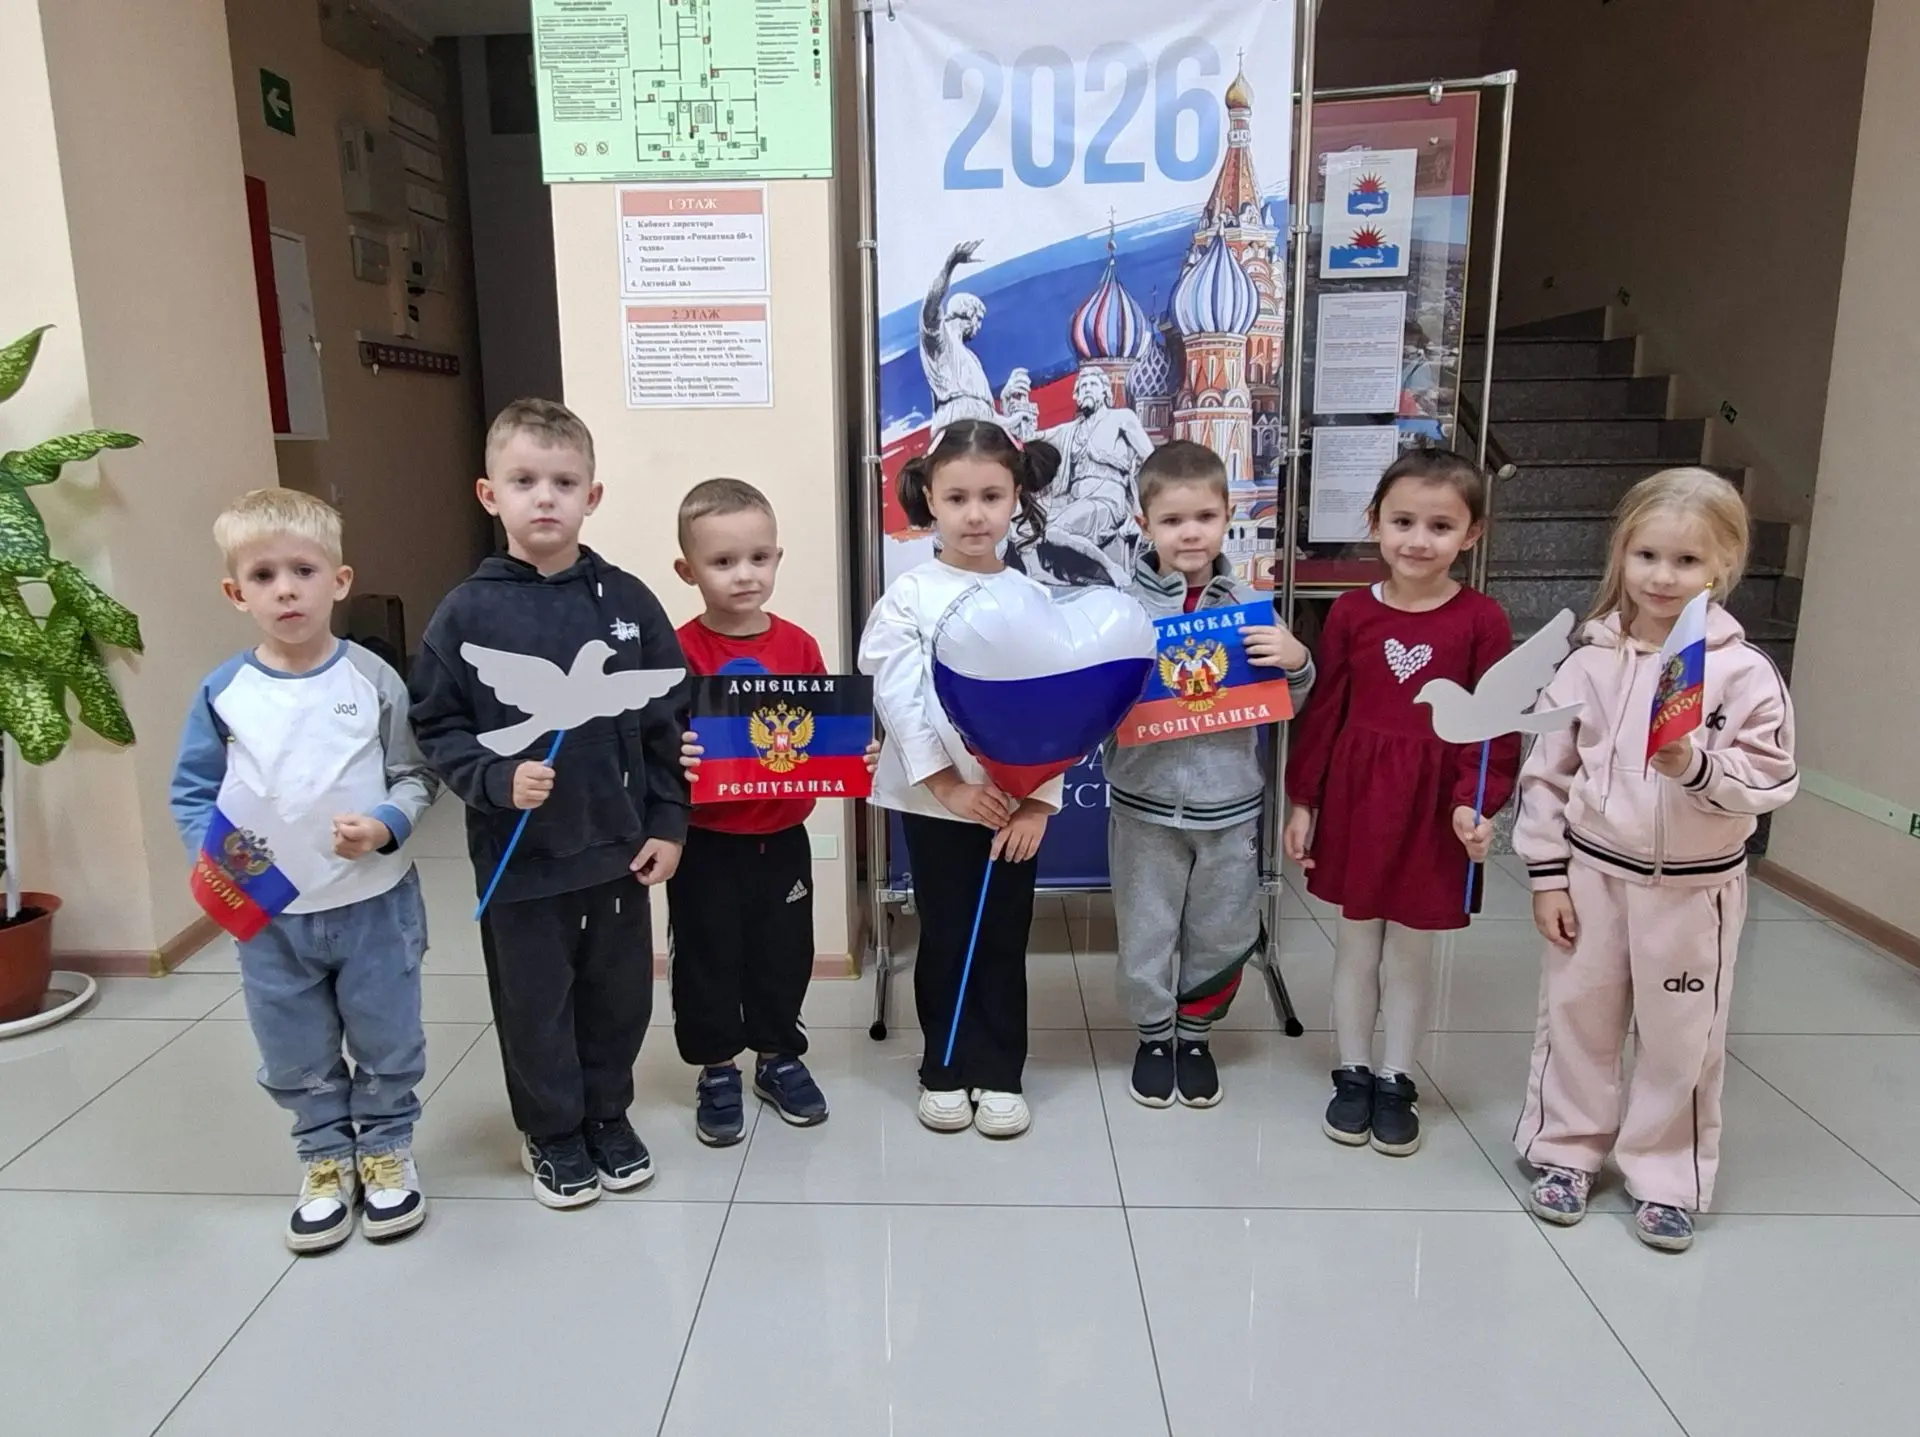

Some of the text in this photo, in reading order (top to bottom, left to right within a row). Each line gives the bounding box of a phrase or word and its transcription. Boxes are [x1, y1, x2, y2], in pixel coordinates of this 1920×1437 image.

[942, 35, 1221, 190] 2026
[676, 197, 719, 210] ЭТАЖ
[637, 220, 671, 229] Кабинет
[673, 220, 714, 230] директора
[640, 279, 676, 288] Актовый
[671, 308, 720, 320] 2 ЭТАЖ
[1155, 610, 1247, 640] ГАНСКАЯ
[728, 679, 835, 695] ДОНЕЦКАЯ
[1136, 703, 1271, 739] РЕСПУБЛИКА
[717, 779, 846, 797] РЕСПУБЛИКА
[1663, 970, 1705, 993] alo
